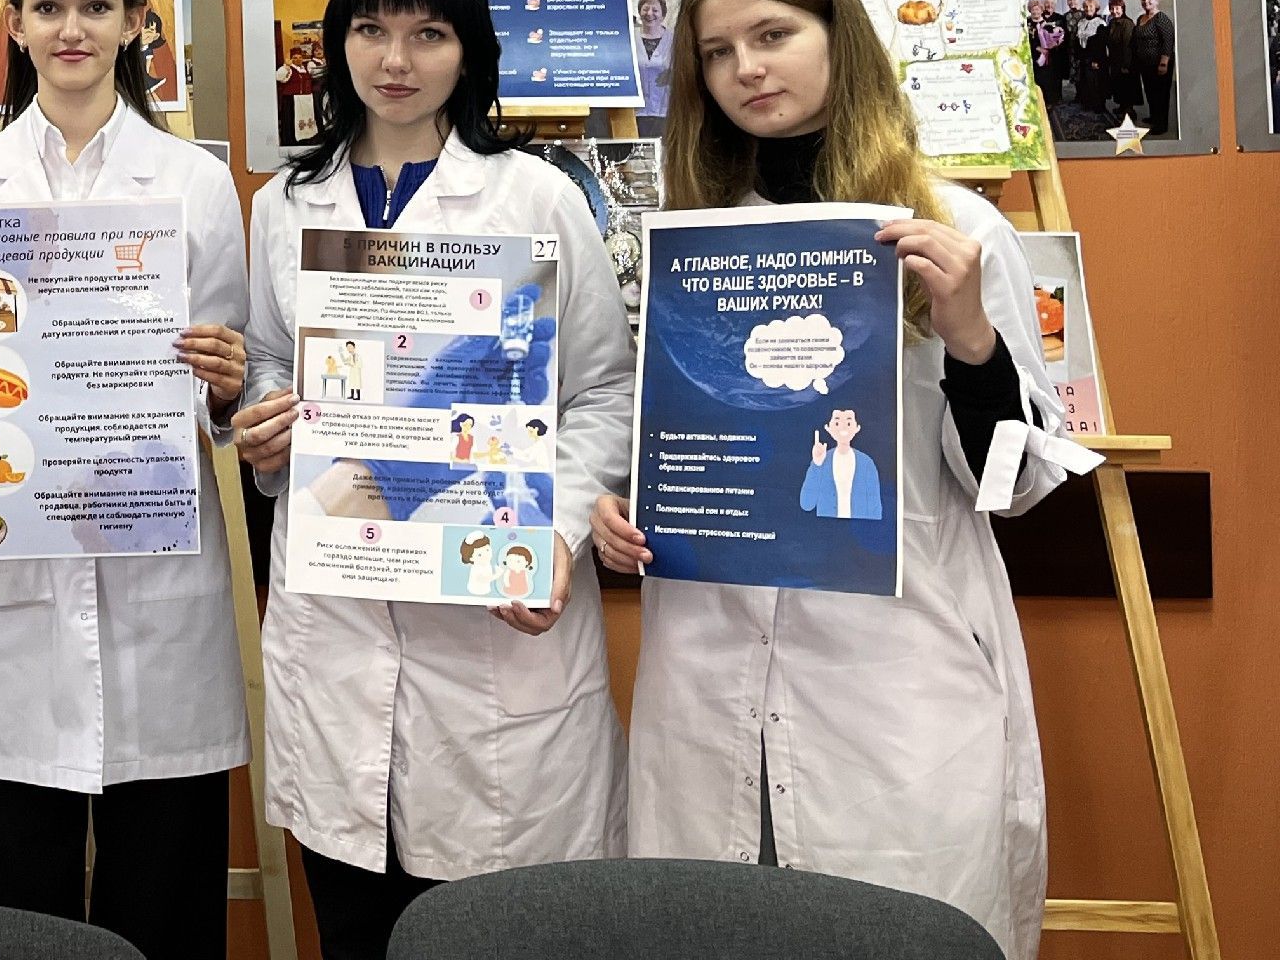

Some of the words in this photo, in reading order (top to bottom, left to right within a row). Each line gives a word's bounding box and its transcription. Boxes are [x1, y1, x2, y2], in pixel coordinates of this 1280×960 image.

[44, 231, 96, 243] правила
[100, 230, 124, 241] при
[128, 228, 177, 241] покупке
[343, 238, 352, 249] 5
[360, 239, 421, 253] ПРИЧИН
[427, 242, 435, 253] В
[440, 242, 501, 256] ПОЛЬЗУ
[534, 240, 557, 258] 27
[39, 249, 105, 262] продукции
[671, 258, 681, 272] А
[685, 255, 752, 272] ГЛАВНОЕ,
[756, 252, 796, 271] НАДО
[800, 248, 877, 266] ПОМНИТЬ,
[368, 255, 475, 271] ВАКЦИНАЦИИ
[39, 275, 83, 285] покупайте
[84, 275, 123, 285] продукты
[682, 278, 710, 292] ЧТО
[713, 276, 754, 291] ВАШЕ
[757, 272, 837, 292] ЗДОРОВЬЕ
[852, 271, 864, 286] В
[38, 285, 110, 295] неустановленной
[111, 285, 149, 294] торговли
[477, 293, 483, 304] 1
[717, 296, 769, 312] ВАШИХ
[773, 294, 822, 311] РУКАХ!
[51, 318, 100, 328] Обращайте
[121, 317, 162, 325] внимание
[42, 331, 60, 340] дату
[61, 329, 119, 338] изготовления
[127, 328, 147, 337] срок
[397, 335, 407, 348] 2
[92, 370, 104, 378] Не
[104, 369, 148, 379] покупайте
[149, 368, 190, 377] продукты
[86, 381, 101, 389] без
[101, 381, 154, 389] маркировки
[303, 410, 312, 420] 3
[660, 431, 685, 441] Будьте
[686, 433, 718, 442] активны,
[719, 434, 757, 442] подвижны
[42, 458, 91, 467] Проверяйте
[92, 456, 144, 465] целостность
[145, 455, 185, 464] упаковки
[659, 452, 721, 462] Придерживайтесь
[722, 455, 760, 464] здорового
[93, 468, 133, 477] продукта
[658, 464, 682, 473] образа
[683, 465, 706, 473] жизни
[658, 483, 724, 495] Сбалансированное
[725, 488, 755, 496] питание
[656, 504, 705, 515] Полноценный
[725, 509, 749, 517] отдых
[501, 512, 510, 523] 4
[366, 528, 375, 539] 5
[654, 525, 697, 535] Исключение
[698, 529, 741, 538] стрессовых
[741, 530, 776, 541] ситуаций
